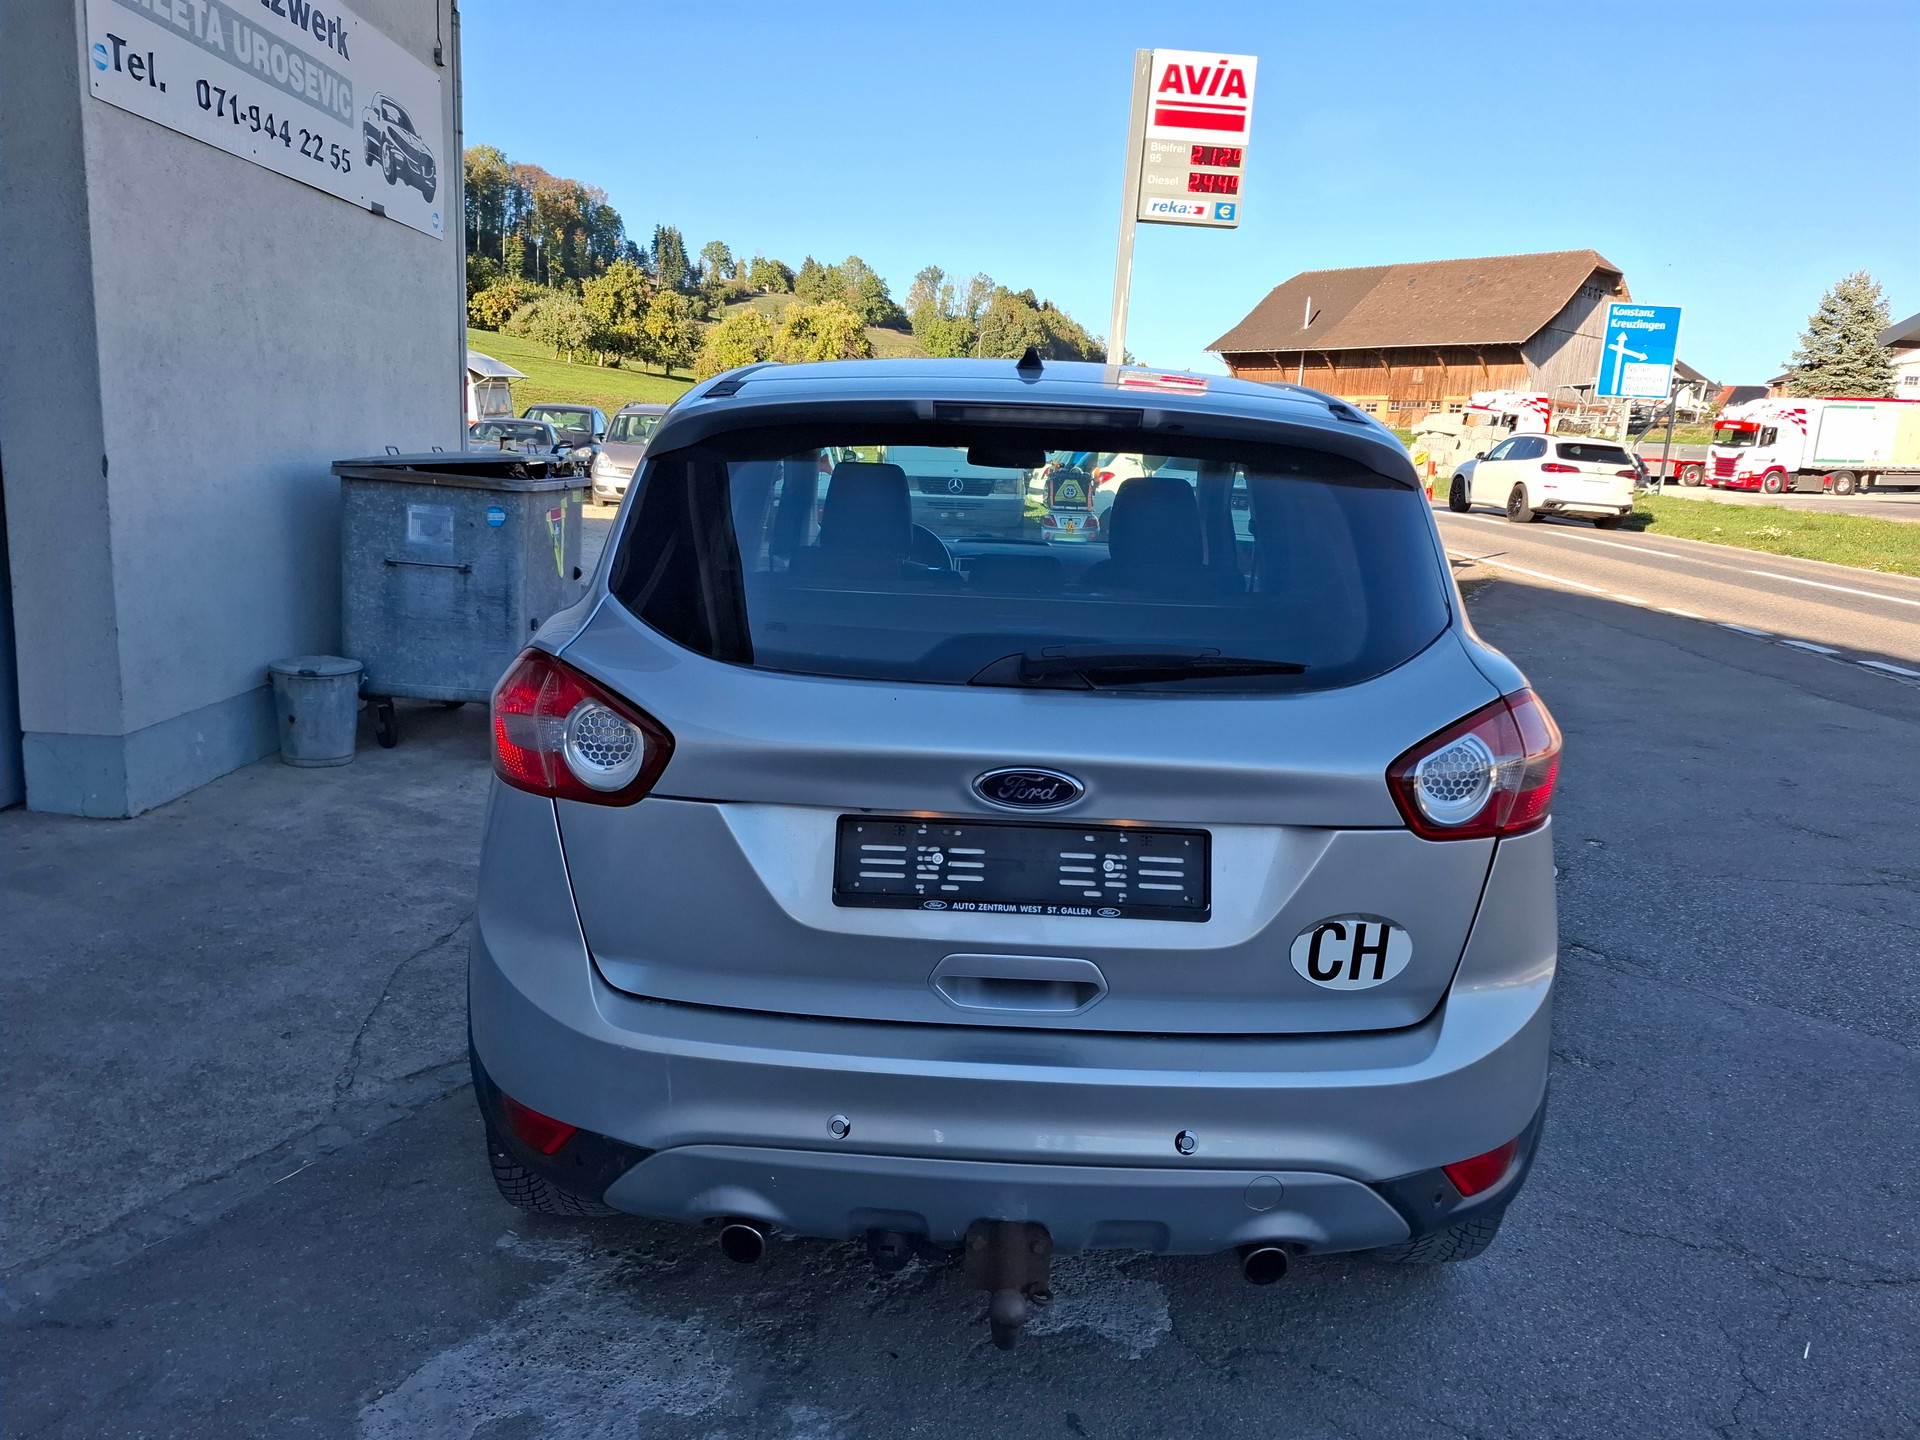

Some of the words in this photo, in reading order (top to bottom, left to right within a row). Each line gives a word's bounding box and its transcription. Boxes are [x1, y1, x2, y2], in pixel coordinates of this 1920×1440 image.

[233, 19, 353, 121] UROSEVIC
[1158, 60, 1247, 99] AVIA
[107, 33, 166, 93] Tel.
[196, 79, 291, 148] 071-944
[300, 128, 324, 163] 22
[330, 143, 352, 173] 55
[1151, 142, 1186, 153] Bleifrei
[1149, 153, 1162, 163] 95
[1147, 174, 1179, 186] Diesel
[1612, 306, 1655, 318] Konstanz
[1610, 318, 1666, 332] Kreuzlingen
[1066, 488, 1075, 496] 25
[998, 775, 1060, 800] Ford
[952, 902, 976, 911] AUTO
[978, 903, 1017, 912] ZENTRUM
[1020, 905, 1042, 914] WEST
[1307, 922, 1391, 981] CH
